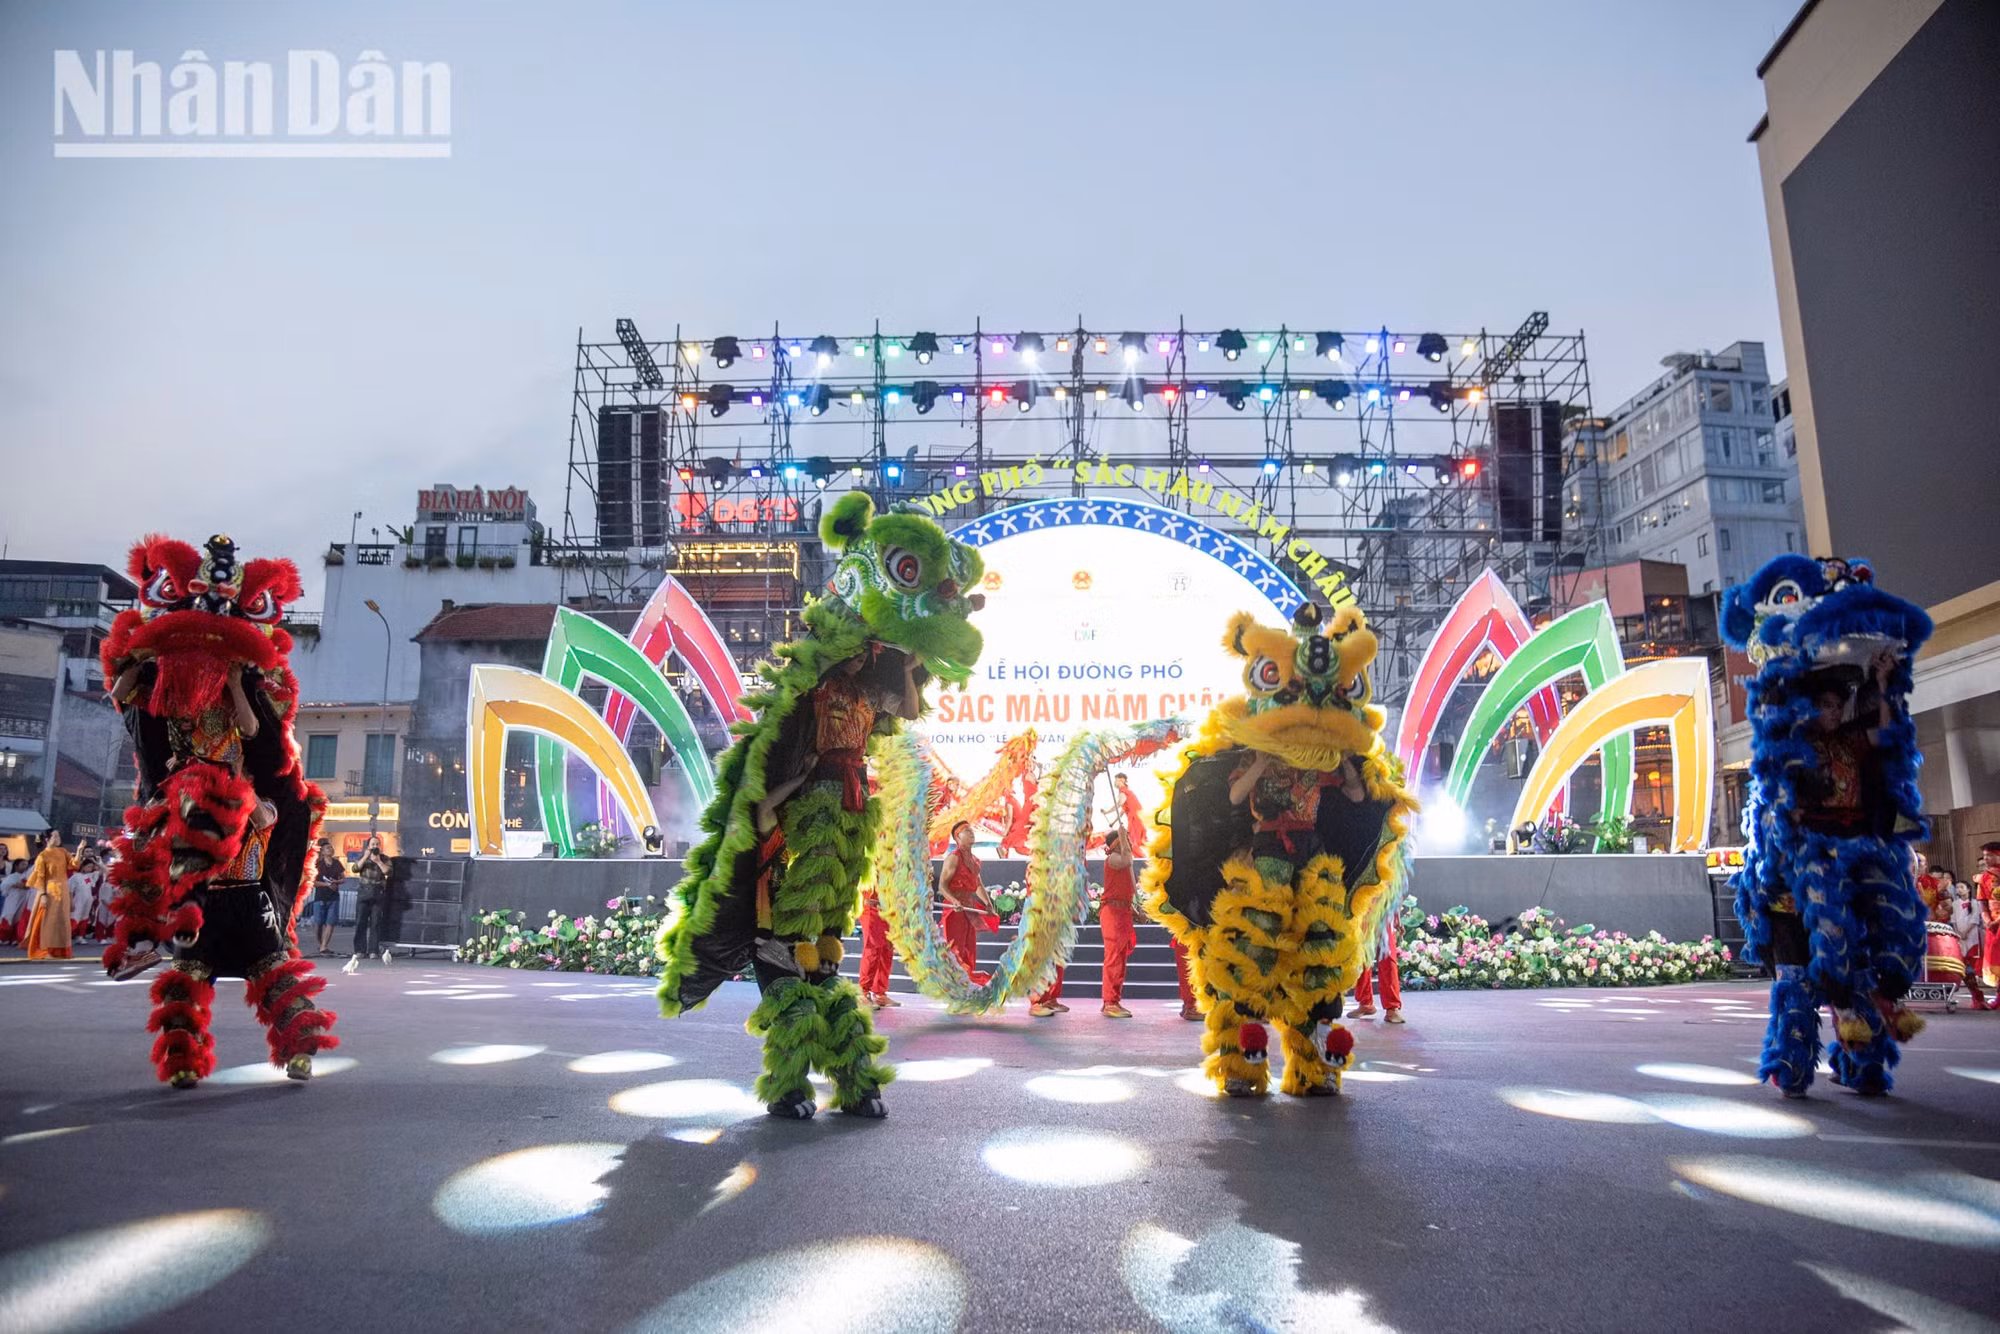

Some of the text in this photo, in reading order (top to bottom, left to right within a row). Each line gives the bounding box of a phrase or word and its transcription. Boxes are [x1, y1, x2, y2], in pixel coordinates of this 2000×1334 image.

[418, 490, 452, 510] BIA
[980, 452, 1044, 496] PHỐ
[1142, 467, 1213, 505] MÀU
[1215, 490, 1291, 544] NĂM
[1014, 661, 1050, 684] HỘI
[1058, 660, 1133, 680] ĐƯỜNG
[1141, 657, 1183, 679] PHỐ
[1006, 688, 1070, 723] MÀU
[1081, 688, 1147, 721] NĂM
[428, 810, 468, 831] CỘN
